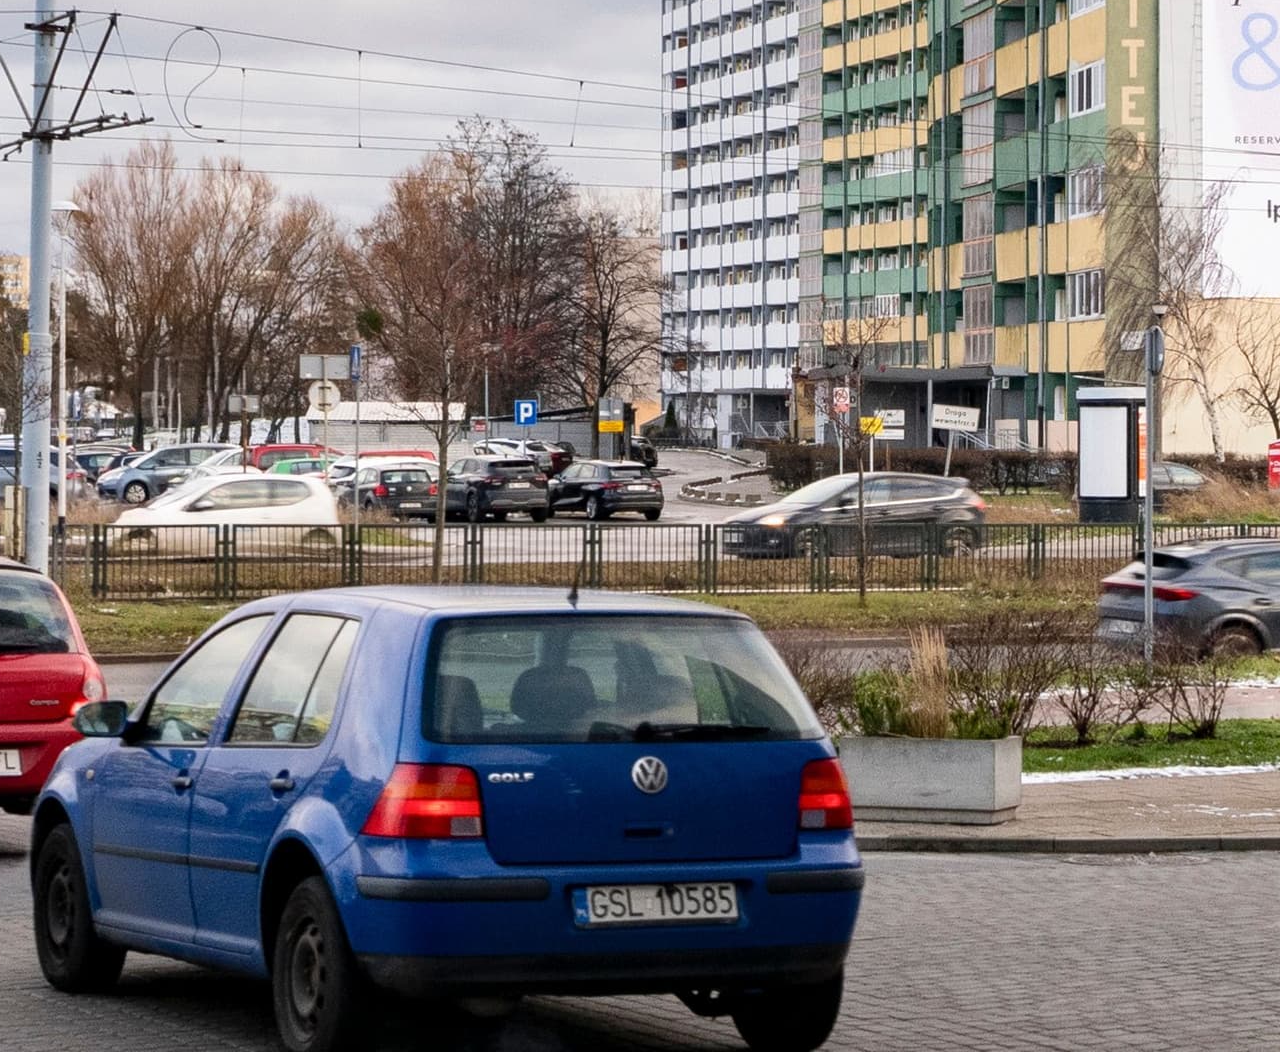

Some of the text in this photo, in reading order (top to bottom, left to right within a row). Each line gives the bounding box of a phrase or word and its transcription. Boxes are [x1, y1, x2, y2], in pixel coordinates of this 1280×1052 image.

[519, 402, 533, 423] P
[488, 772, 535, 783] GOLF
[589, 889, 644, 919] GSL
[656, 885, 734, 918] 10585
